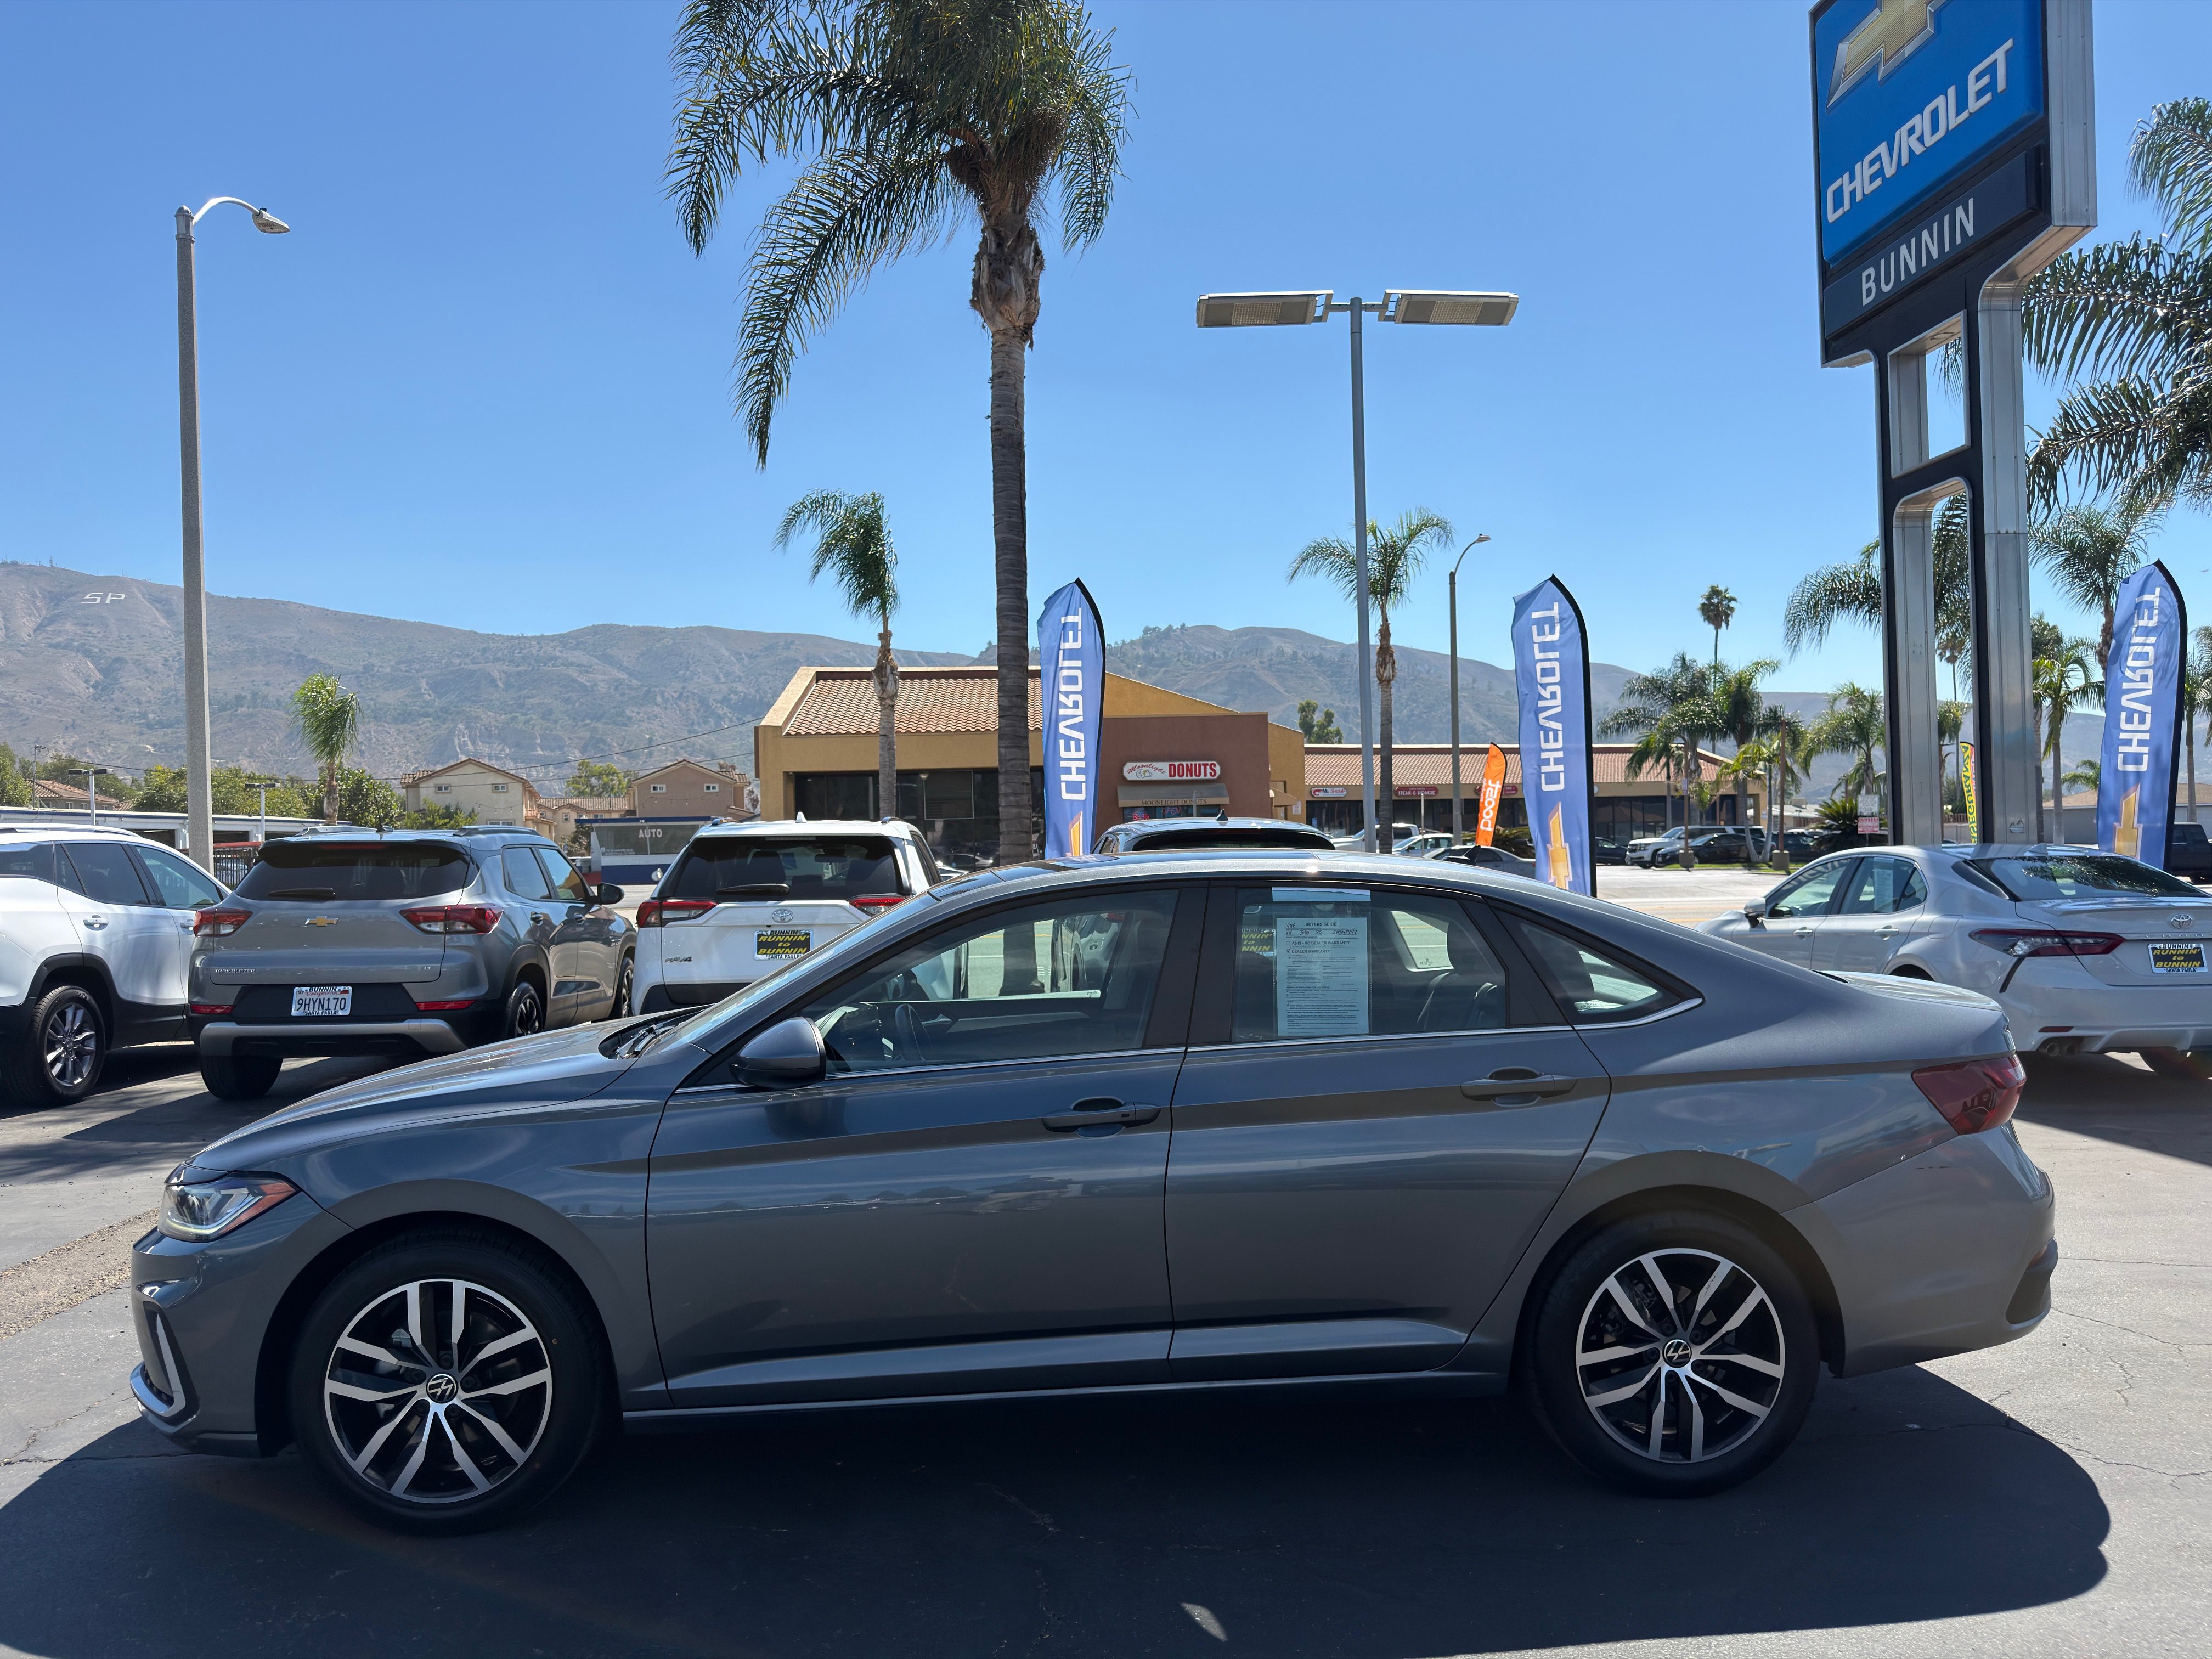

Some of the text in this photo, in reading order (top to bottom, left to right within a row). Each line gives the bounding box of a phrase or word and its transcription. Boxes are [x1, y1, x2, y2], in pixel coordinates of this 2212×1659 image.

[1827, 38, 2013, 223] CHEVROLET
[1861, 197, 1974, 306] BUNNIN
[81, 592, 125, 603] SP
[1126, 763, 1216, 777] Moonlight DONUTS
[639, 829, 662, 838] AUTO
[297, 998, 346, 1011] 9HYN170
